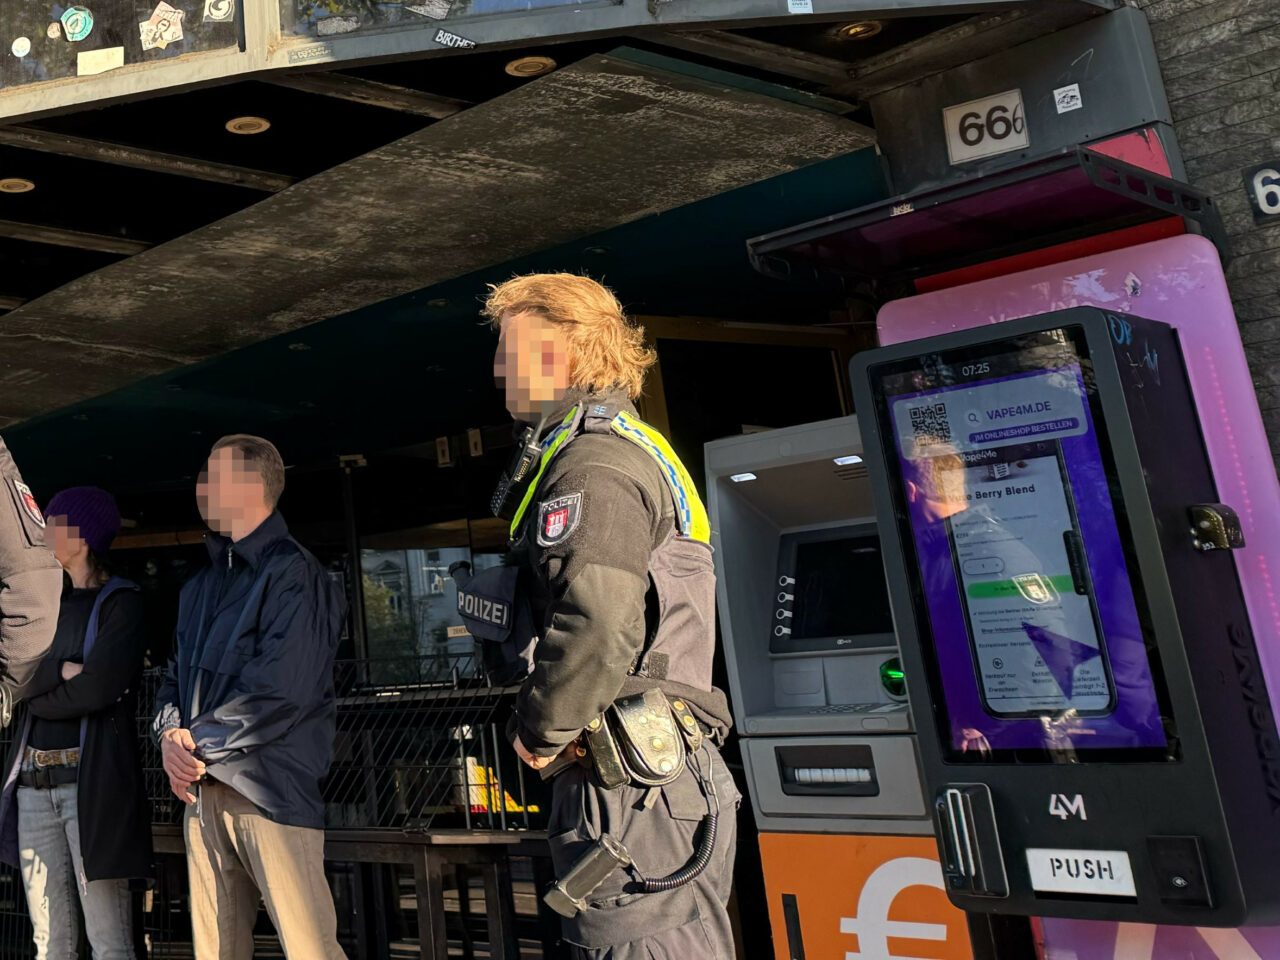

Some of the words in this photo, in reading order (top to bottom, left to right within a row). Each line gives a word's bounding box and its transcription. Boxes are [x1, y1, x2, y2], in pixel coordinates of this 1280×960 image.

[962, 362, 990, 377] 07:25
[986, 401, 1053, 421] VAPE4M.DE
[984, 426, 1031, 442] ONLINESHOP
[1031, 420, 1073, 434] BESTELLEN
[975, 488, 1003, 501] Berry
[1006, 484, 1036, 496] Blend
[543, 497, 577, 512] POLIZEI
[458, 591, 507, 626] POLIZEI
[1050, 857, 1115, 881] PUSH
